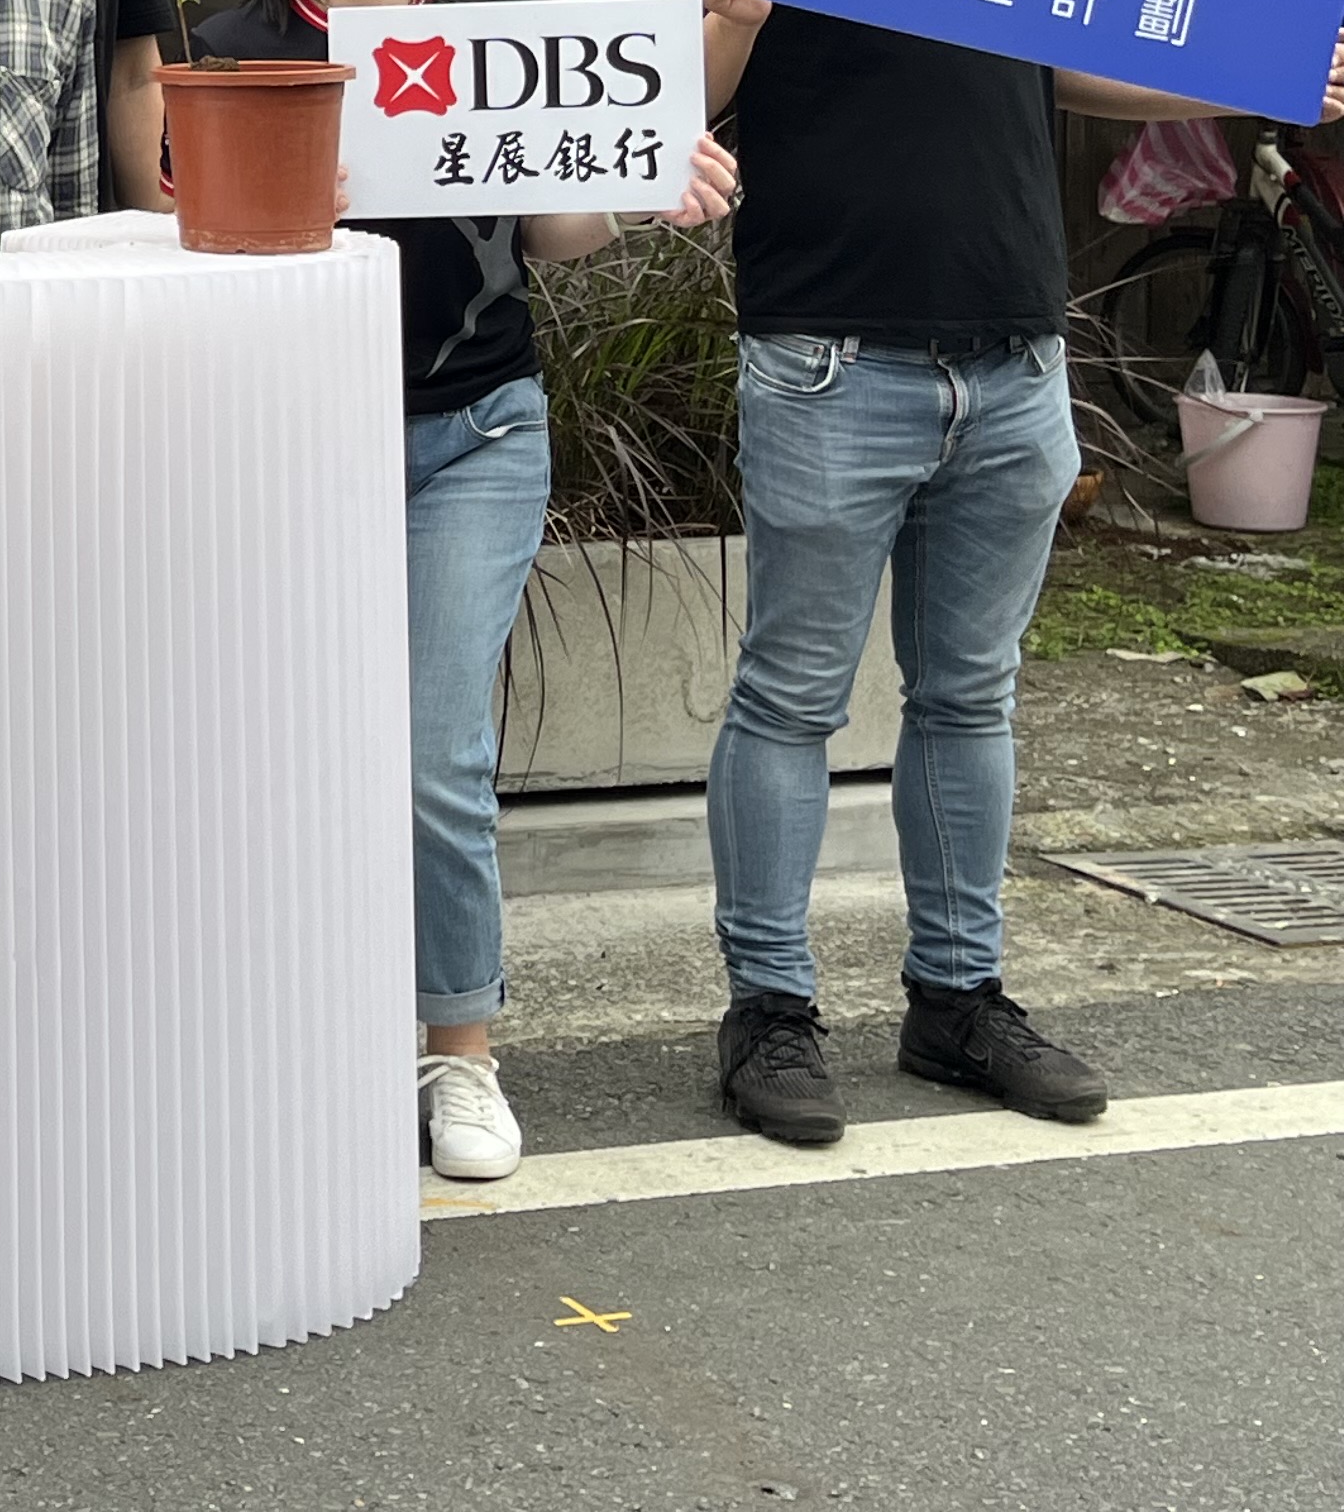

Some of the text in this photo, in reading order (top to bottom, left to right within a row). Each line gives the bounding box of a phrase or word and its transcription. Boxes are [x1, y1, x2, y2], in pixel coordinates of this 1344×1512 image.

[467, 32, 662, 112] DBS
[433, 127, 665, 187] 星展銀行
